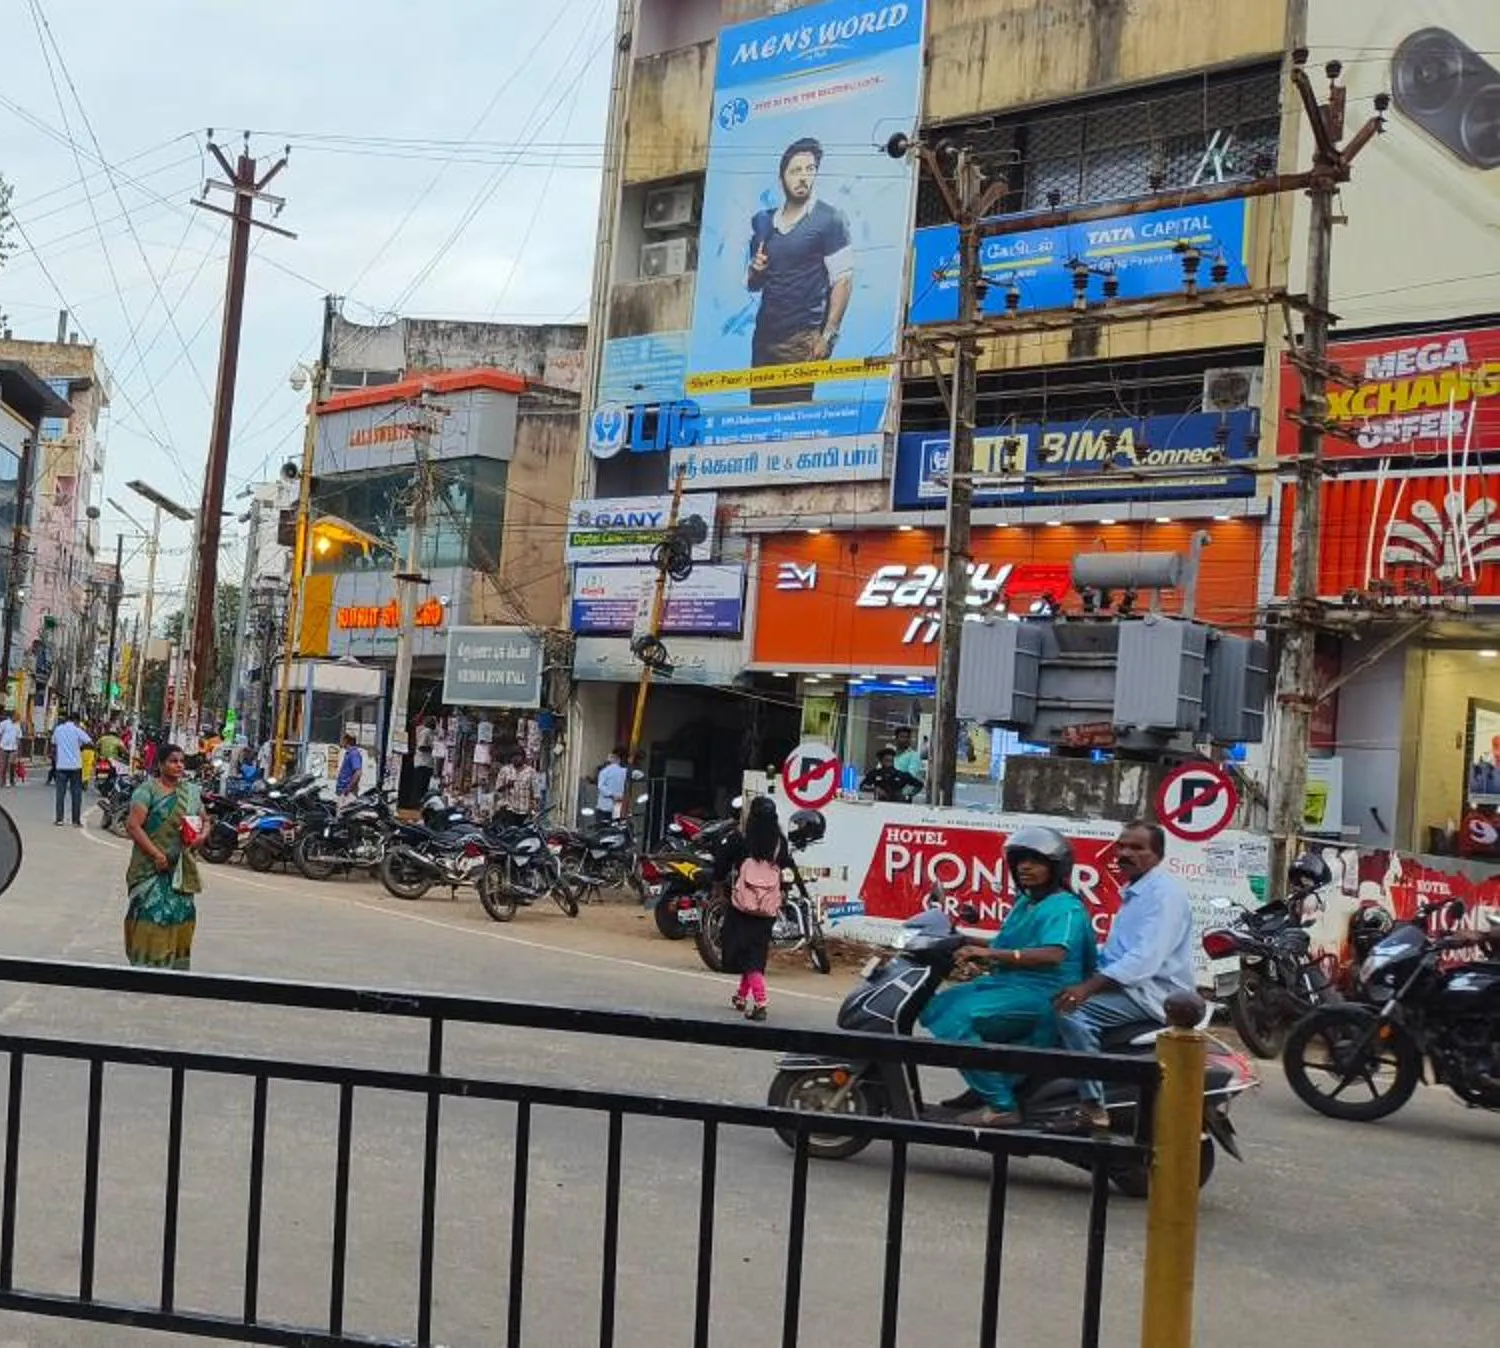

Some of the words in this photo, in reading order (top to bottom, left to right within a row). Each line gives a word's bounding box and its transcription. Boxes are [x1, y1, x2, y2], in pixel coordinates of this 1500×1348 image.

[818, 3, 908, 45] WORLD
[1088, 226, 1135, 245] TATA
[1141, 215, 1213, 238] CAPITAL
[1364, 338, 1468, 379] MEGA
[1326, 362, 1500, 422] XCHANG
[631, 400, 700, 452] LIC
[1044, 428, 1135, 463] BIMA
[1357, 409, 1466, 449] OFFER
[886, 828, 947, 846] HOTEL
[885, 844, 1102, 906] PIONR
[922, 892, 1013, 925] GRND
